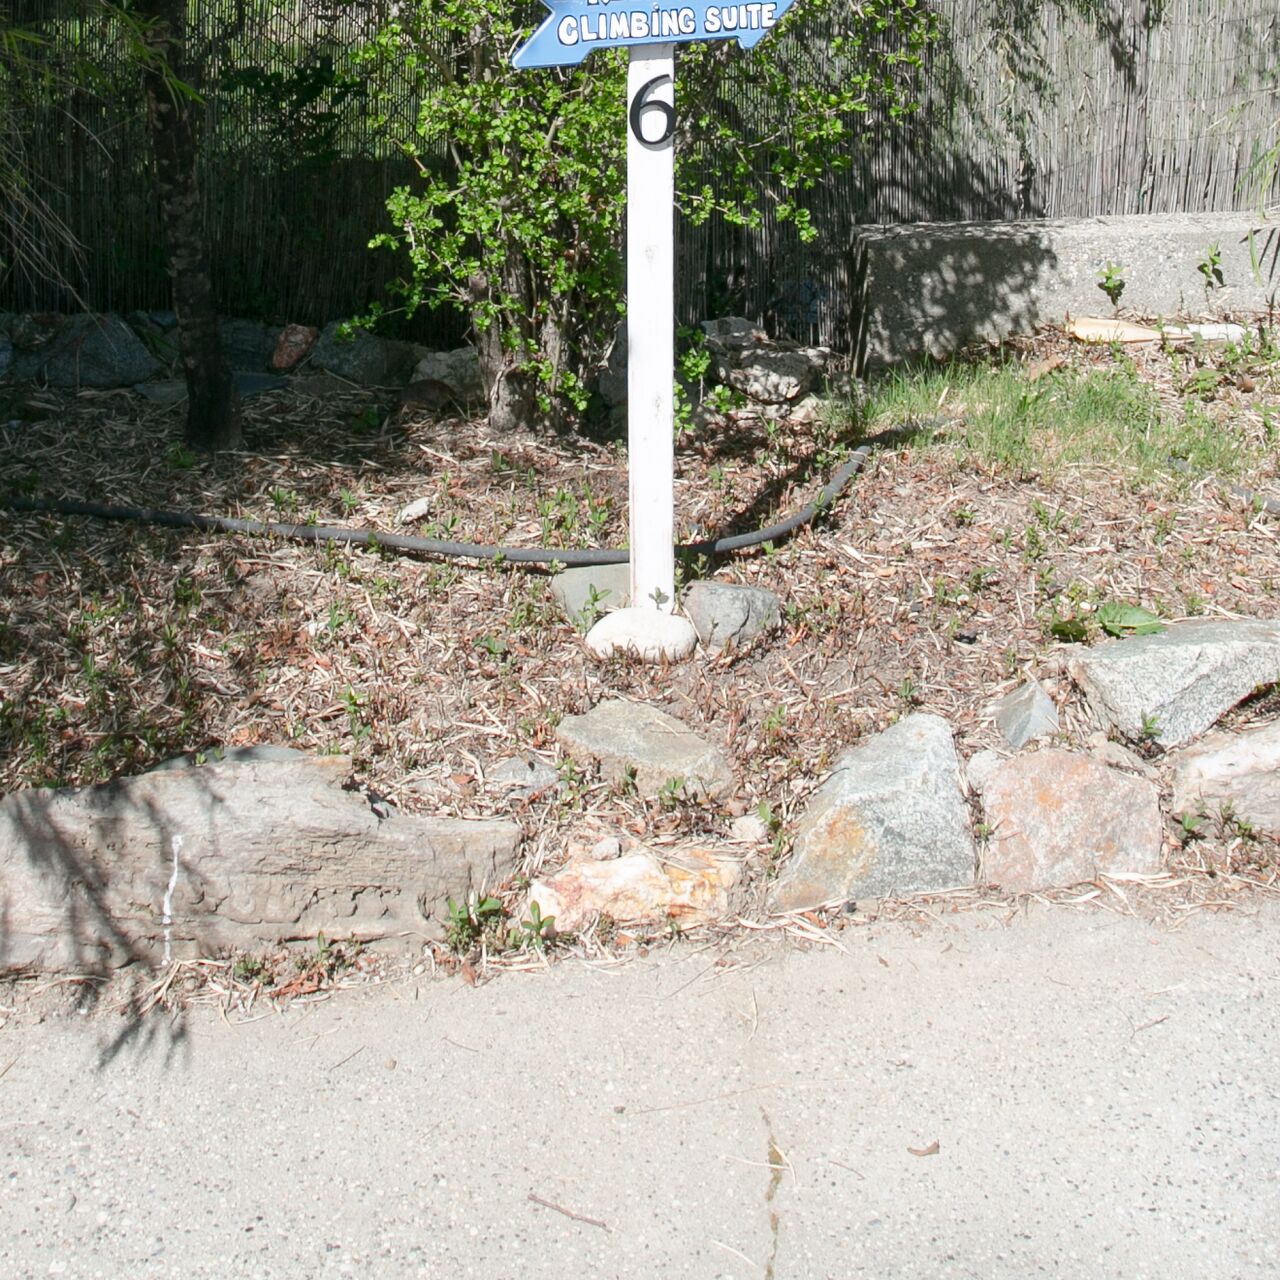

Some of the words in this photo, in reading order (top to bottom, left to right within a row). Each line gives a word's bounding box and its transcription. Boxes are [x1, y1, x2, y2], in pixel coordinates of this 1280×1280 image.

[557, 6, 696, 46] CLIMBING
[704, 2, 777, 33] SUITE
[629, 73, 677, 146] 6
